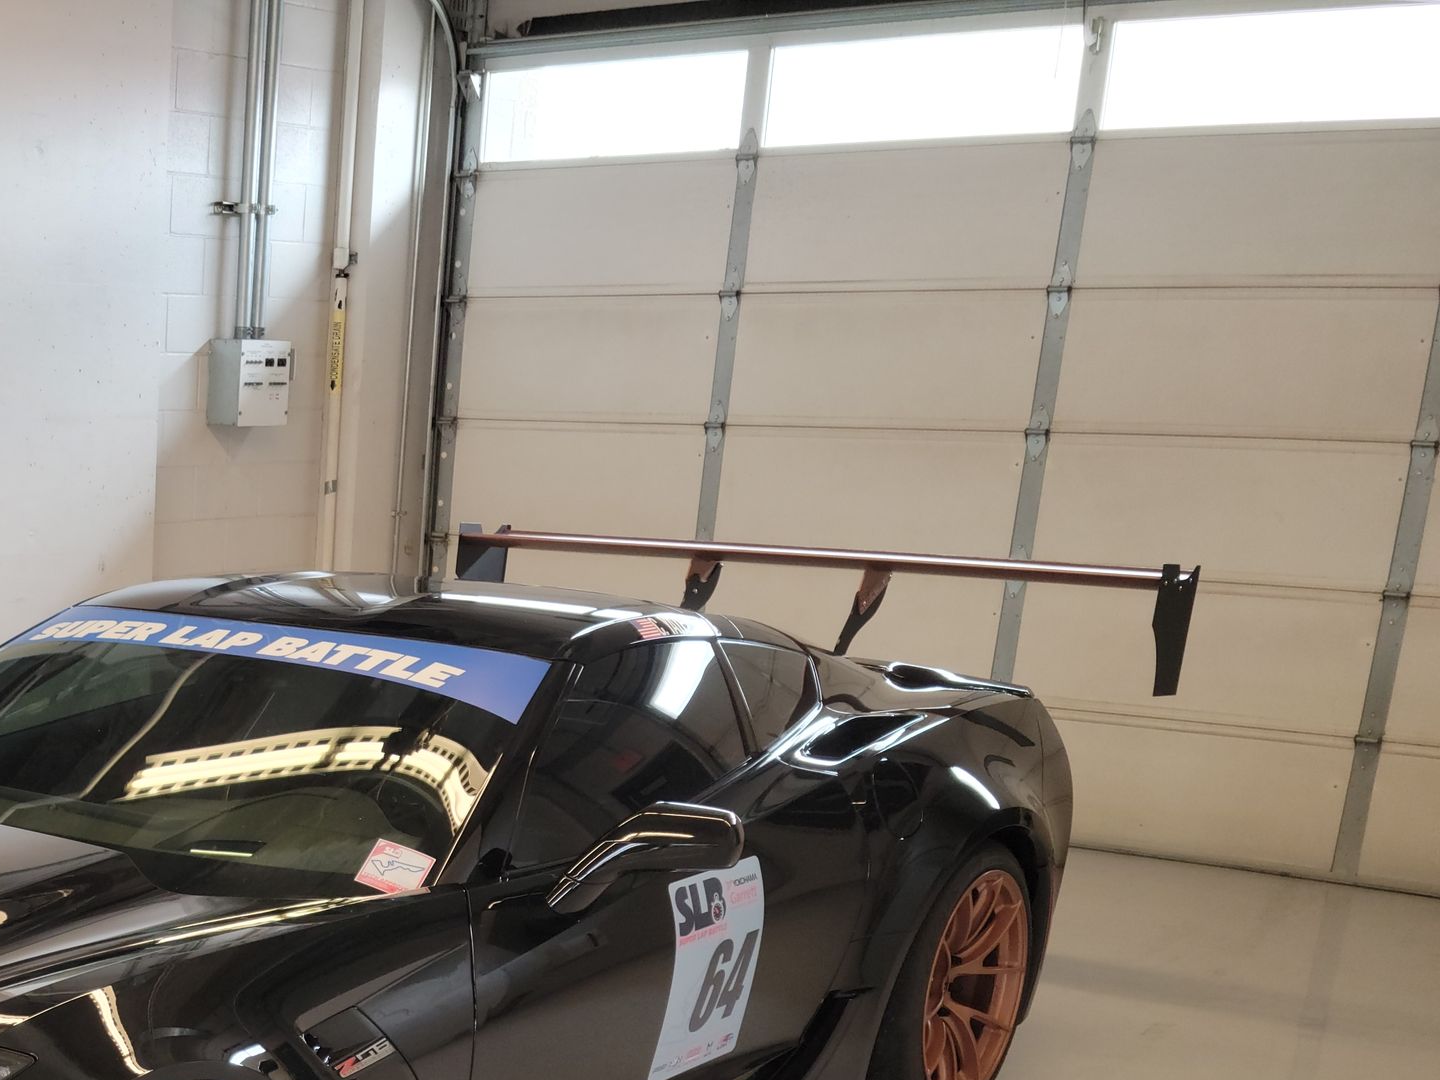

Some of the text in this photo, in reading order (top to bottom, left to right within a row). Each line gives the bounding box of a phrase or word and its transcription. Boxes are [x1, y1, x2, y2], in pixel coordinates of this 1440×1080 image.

[329, 321, 342, 380] CONDENSATE DRAIN
[28, 620, 466, 688] SUPER LAP BATTLE
[675, 877, 727, 937] SLB
[688, 928, 760, 1033] 64
[334, 1037, 390, 1077] Z06
